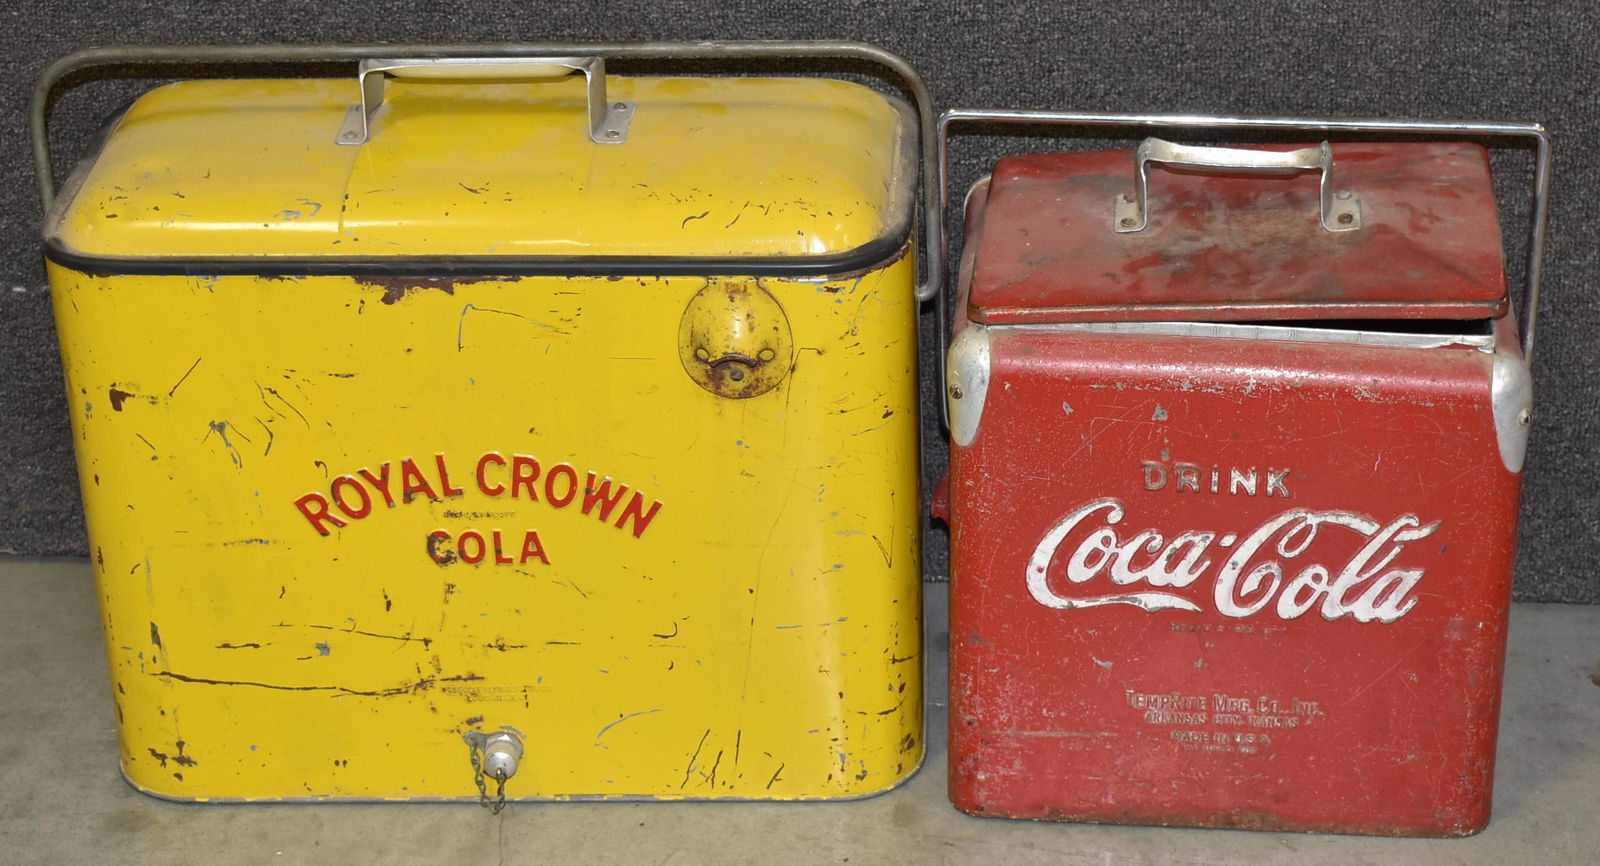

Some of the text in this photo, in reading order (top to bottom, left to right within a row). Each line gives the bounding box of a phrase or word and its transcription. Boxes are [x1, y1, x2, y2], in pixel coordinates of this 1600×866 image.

[293, 450, 664, 540] ROYAL CROWN
[1141, 461, 1292, 498] DRINK
[426, 528, 551, 567] COLA
[1025, 496, 1442, 625] Coca-Cola
[1144, 711, 1208, 725] ARKANSAS
[1169, 730, 1210, 743] MADE
